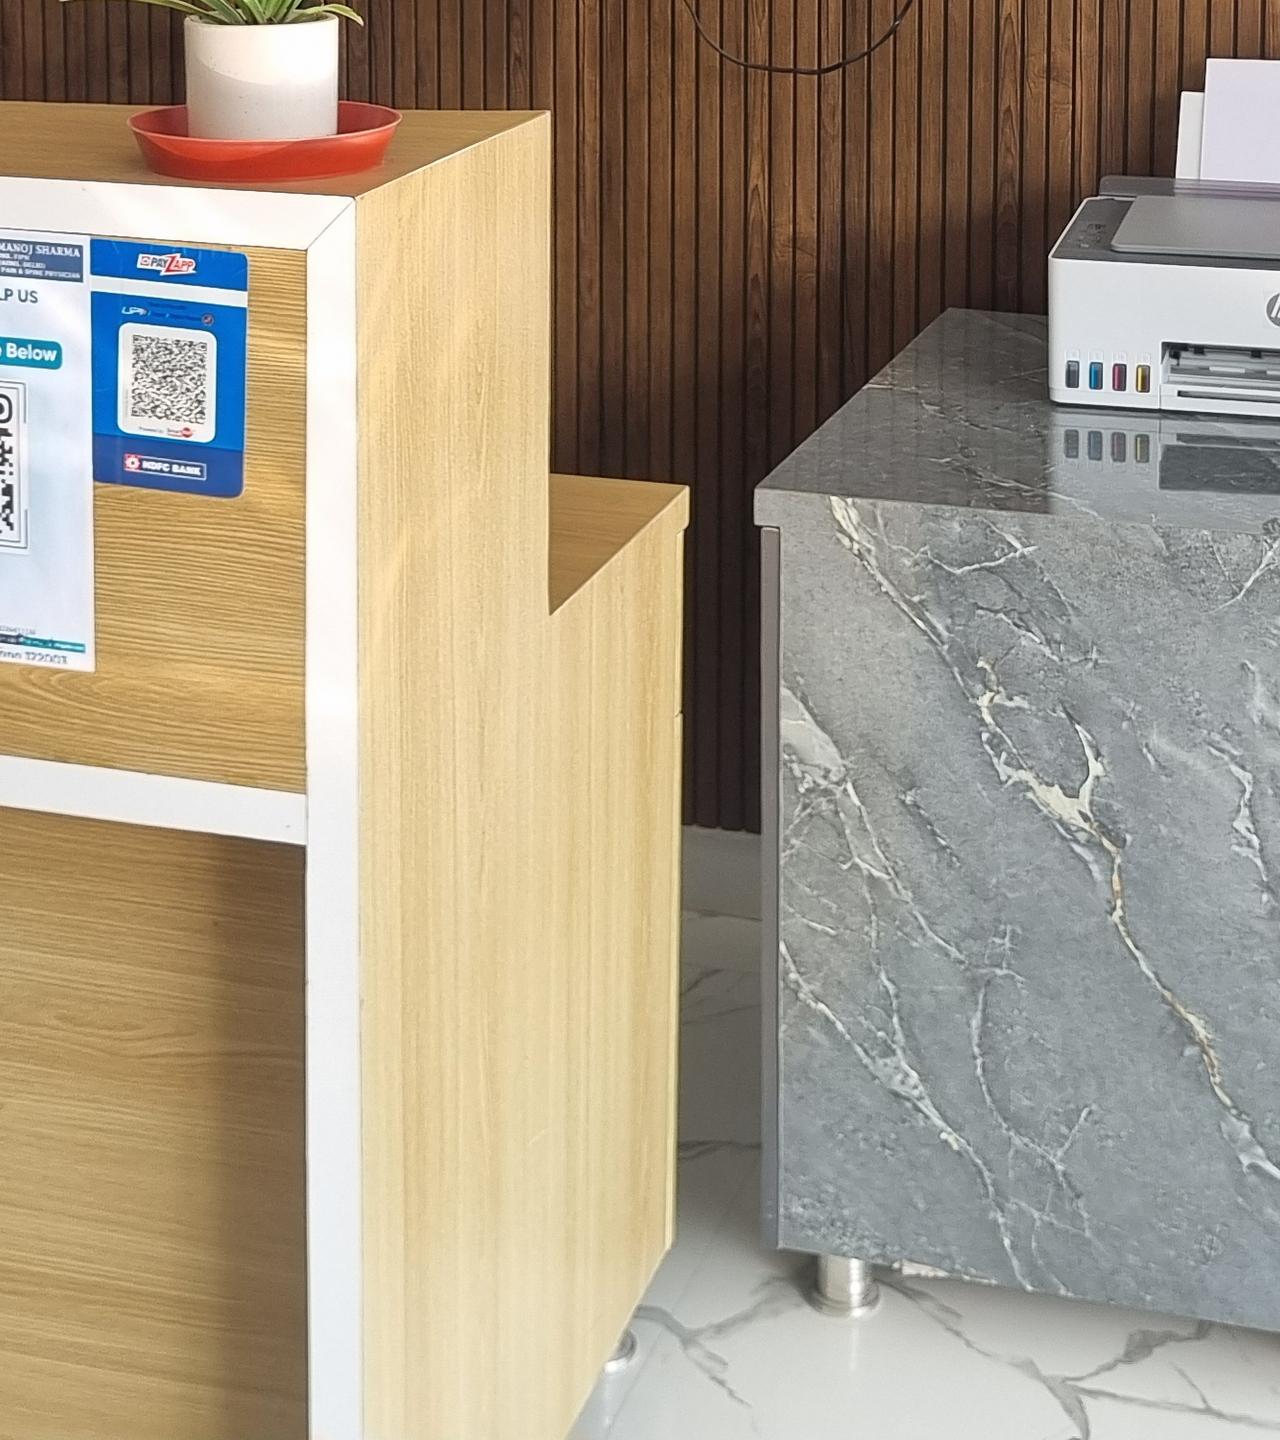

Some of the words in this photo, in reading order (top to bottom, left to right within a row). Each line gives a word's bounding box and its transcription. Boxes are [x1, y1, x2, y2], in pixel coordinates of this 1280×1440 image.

[35, 245, 81, 258] SHARMA
[17, 289, 39, 304] US
[6, 343, 58, 362] Below
[141, 460, 170, 472] HDFC
[172, 464, 202, 476] BANK
